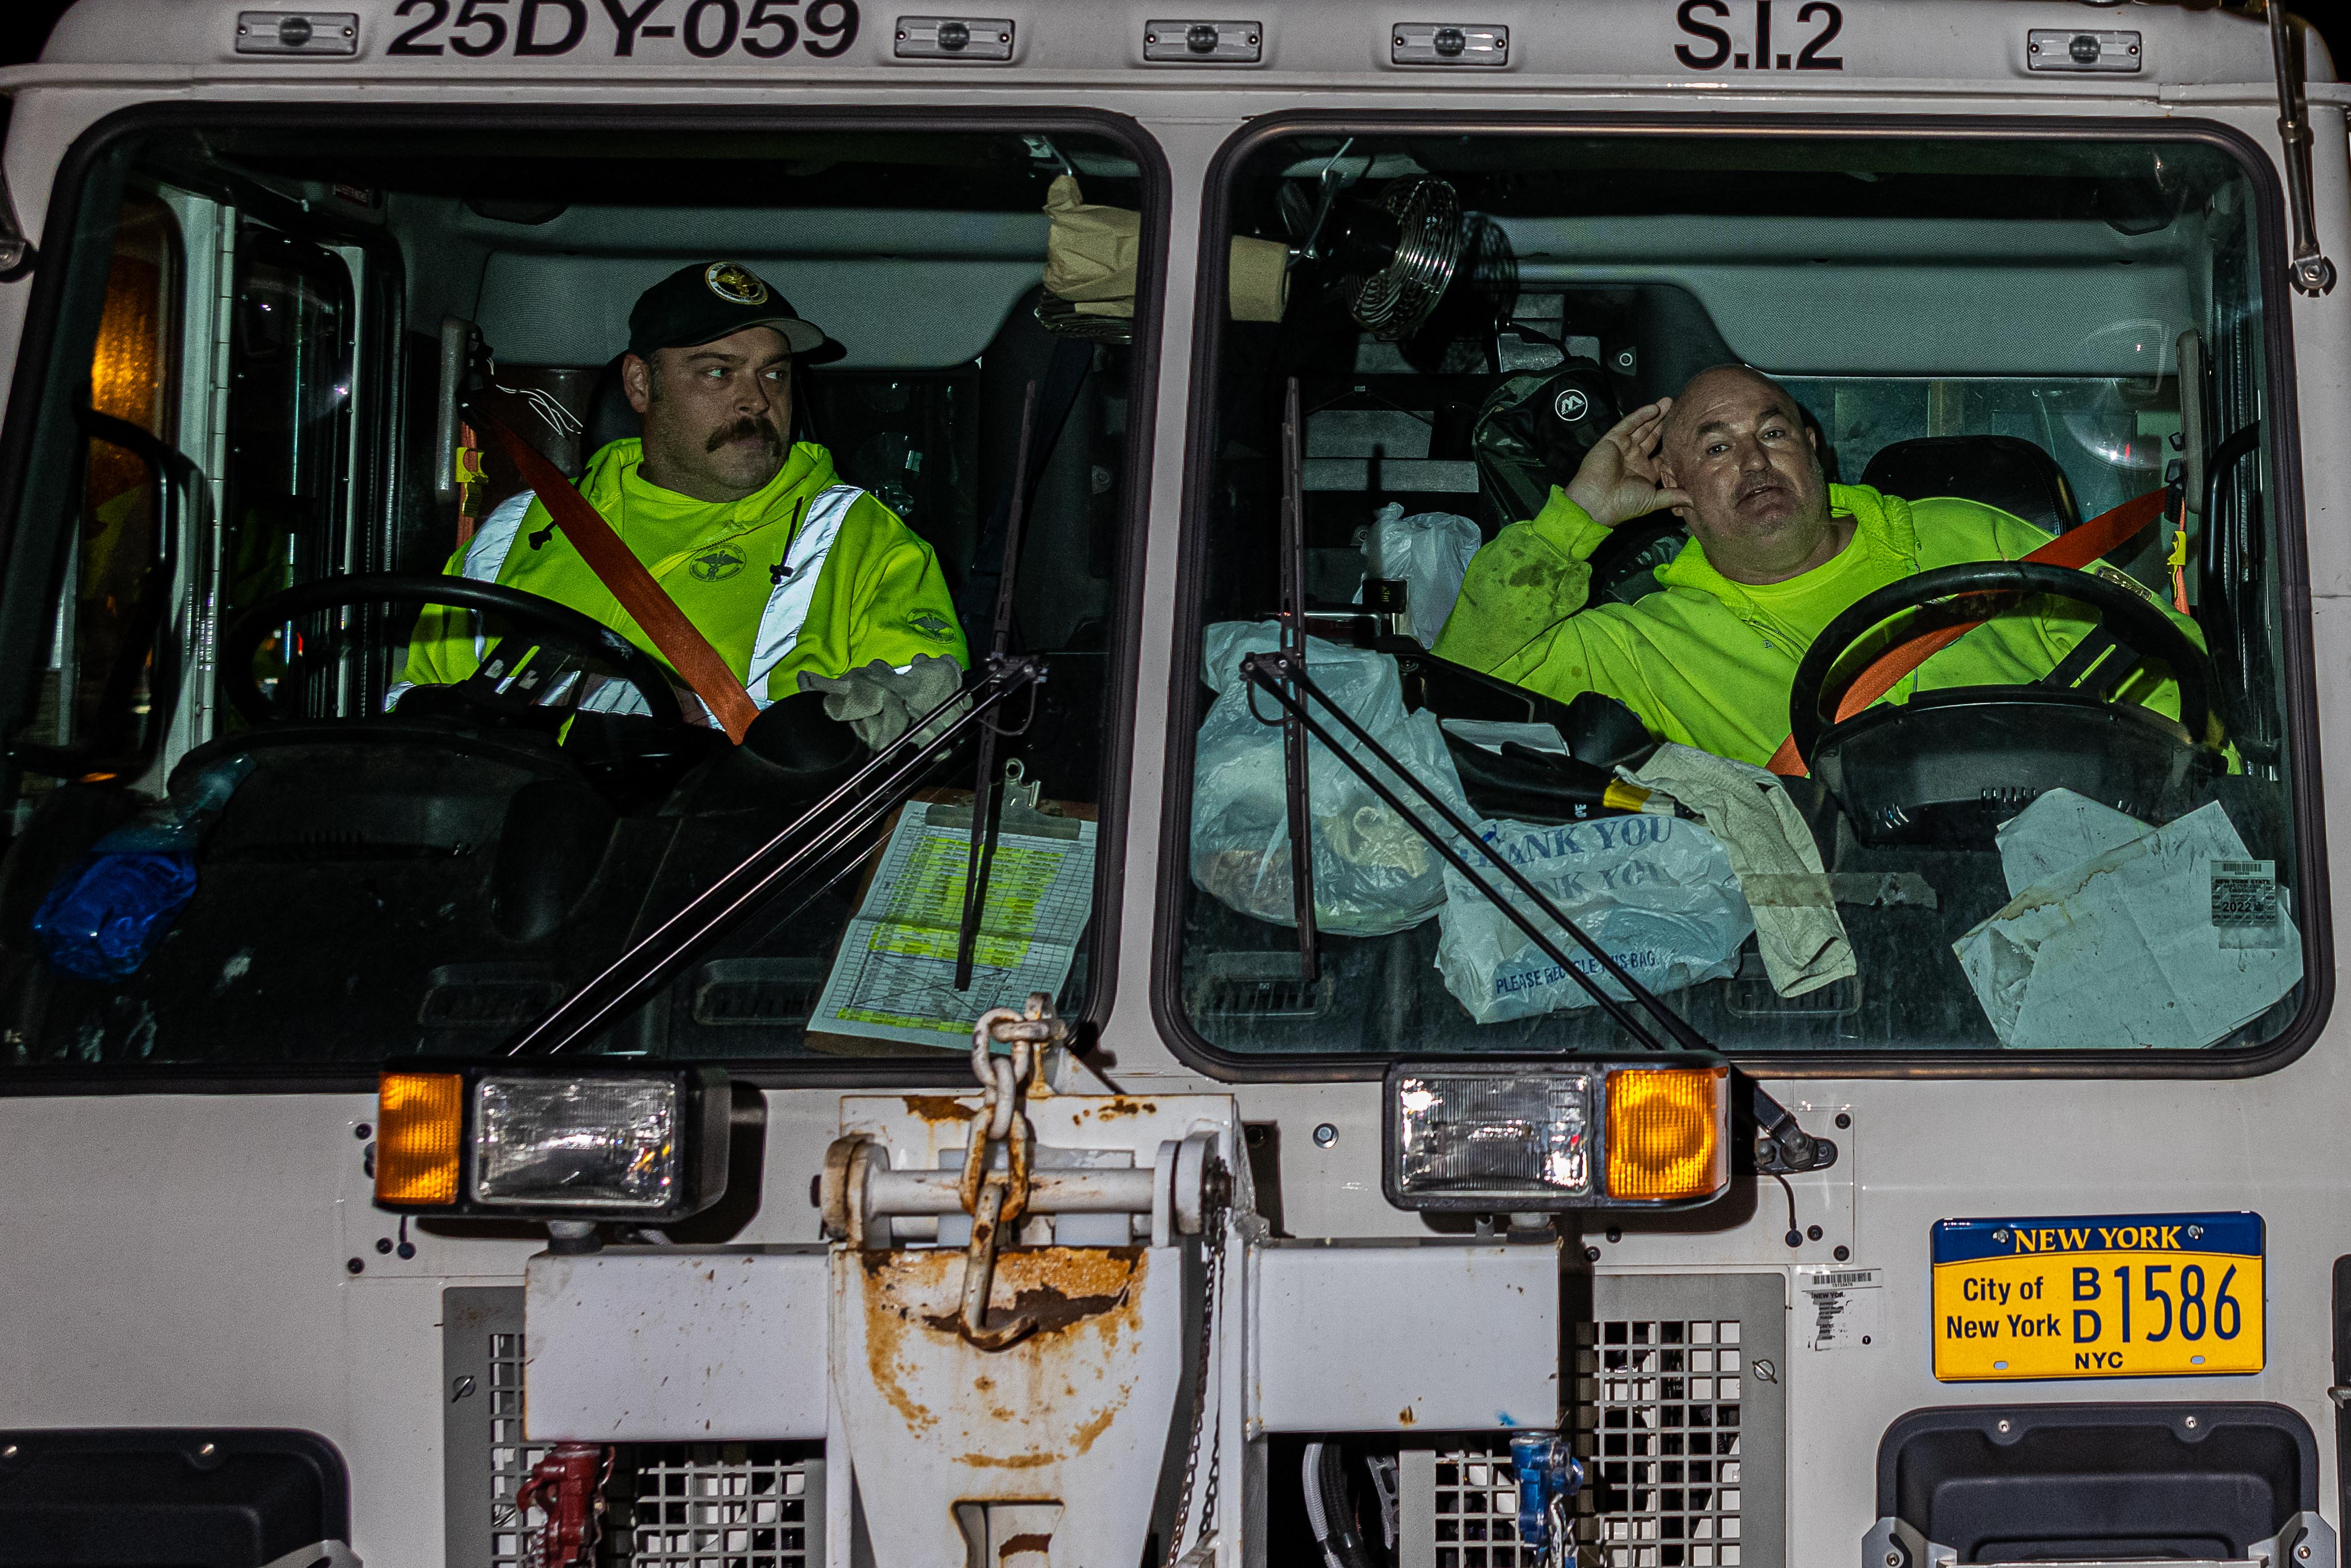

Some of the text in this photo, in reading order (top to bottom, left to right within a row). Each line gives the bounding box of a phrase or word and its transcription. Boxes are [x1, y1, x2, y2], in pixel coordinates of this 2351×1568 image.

[386, 0, 860, 58] 25DY-059
[1674, 0, 1844, 71] S.I.2
[1459, 817, 1672, 867] ANK YOU
[2223, 902, 2252, 912] 2022
[1496, 970, 1542, 994] PLEASE
[1545, 958, 1597, 984] RECCLE
[2014, 1225, 2182, 1253] NEW YORK
[1963, 1276, 2044, 1306] City of
[2114, 1264, 2241, 1343] 1586
[1946, 1313, 2061, 1339] New York
[2075, 1352, 2124, 1369] NYC
